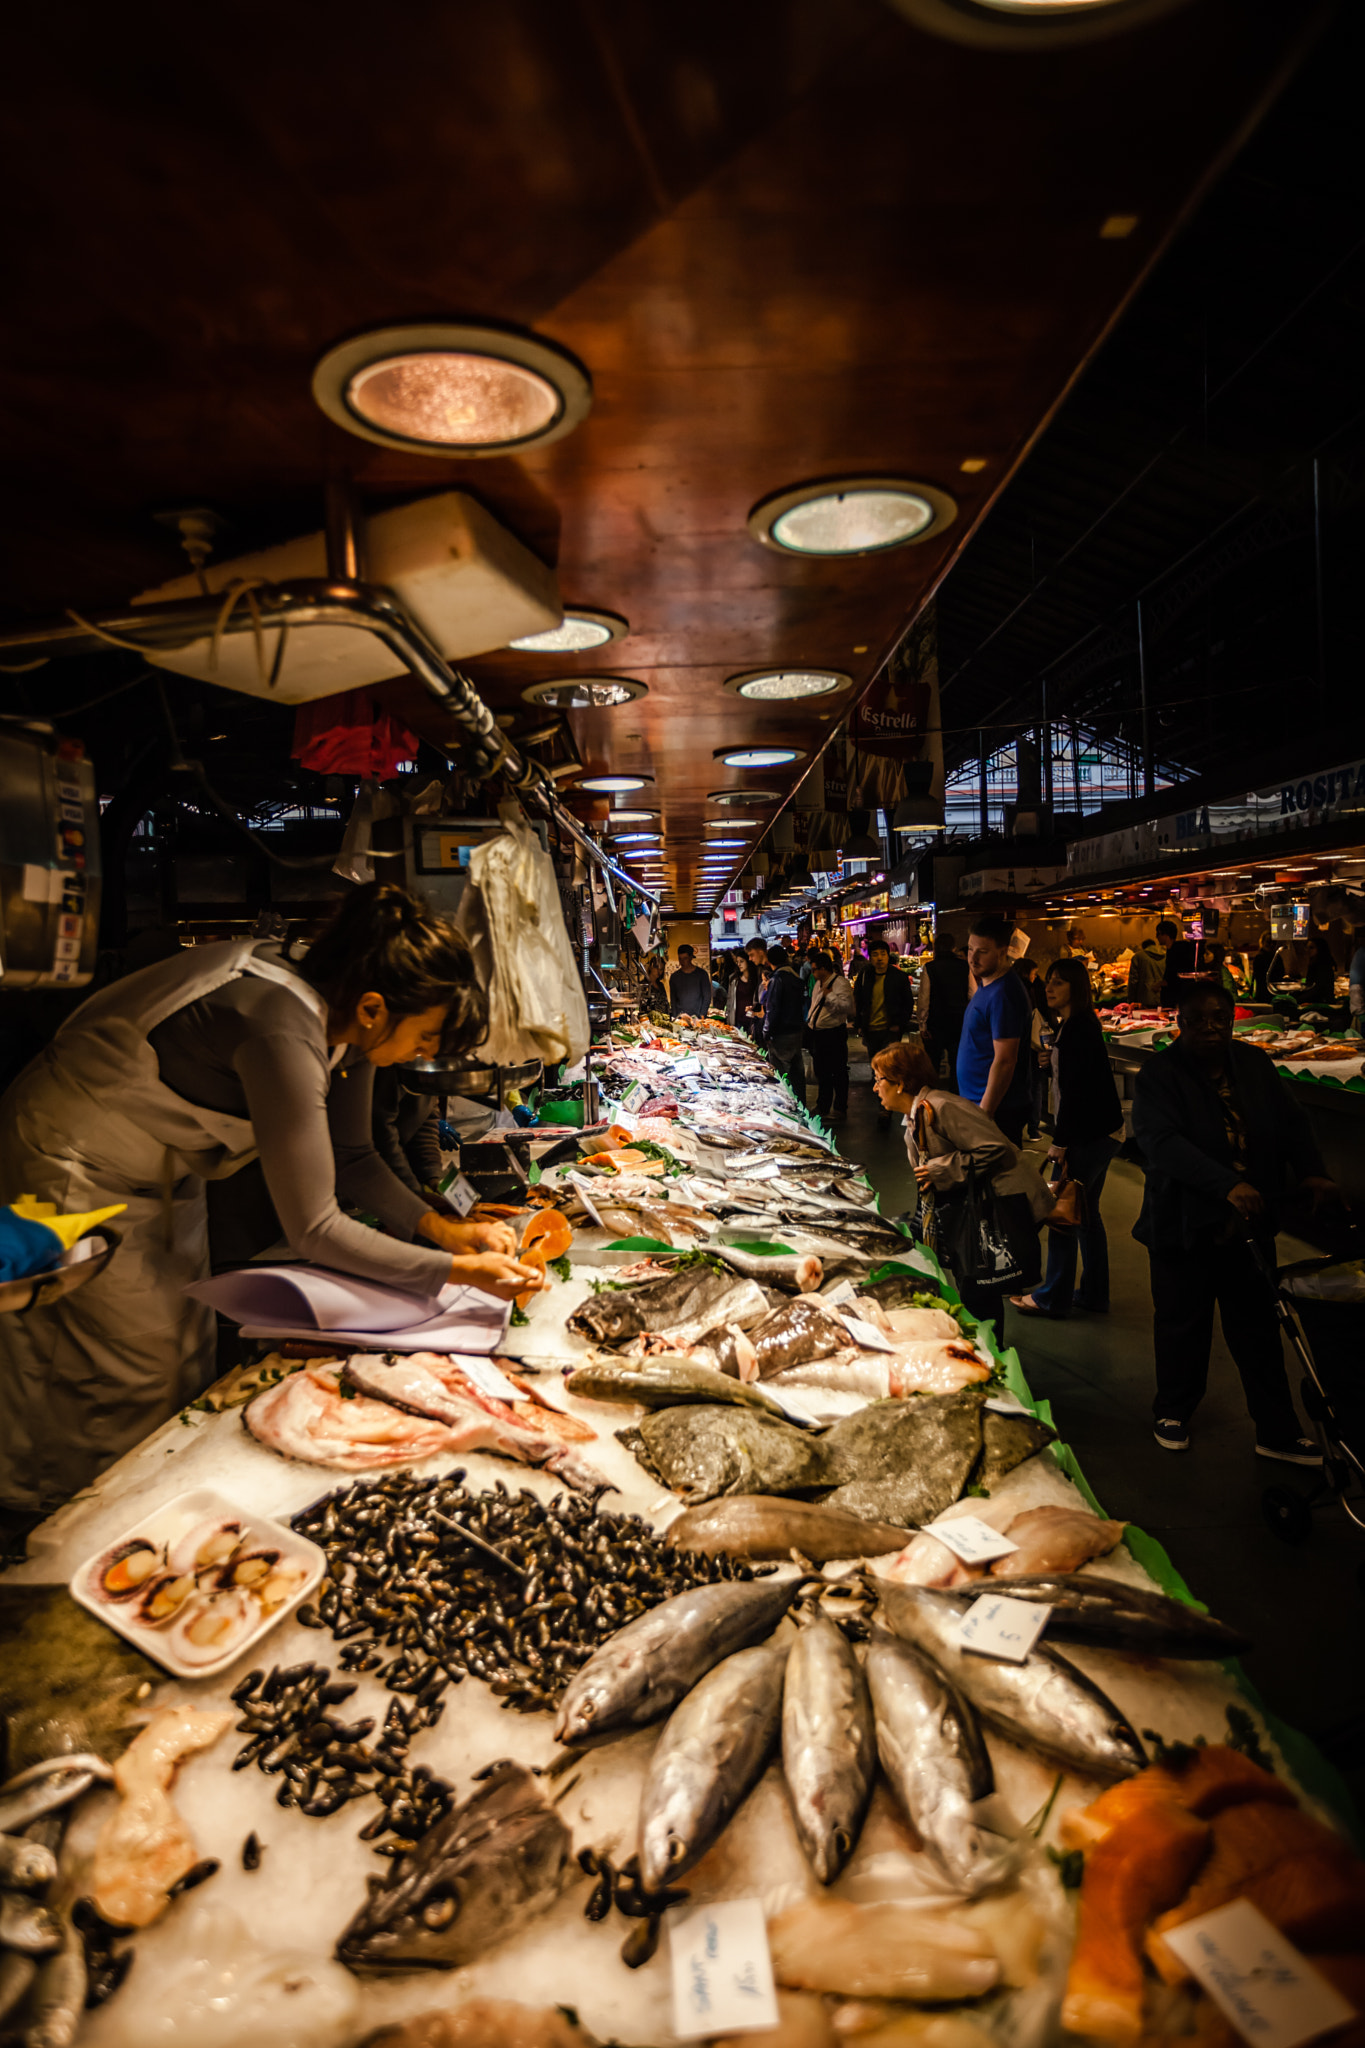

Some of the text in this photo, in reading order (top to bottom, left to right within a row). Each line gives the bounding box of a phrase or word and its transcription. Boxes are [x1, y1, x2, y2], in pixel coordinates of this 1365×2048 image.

[861, 705, 917, 729] Estrella
[1175, 805, 1211, 840] BEA
[1280, 765, 1365, 815] ROSITA
